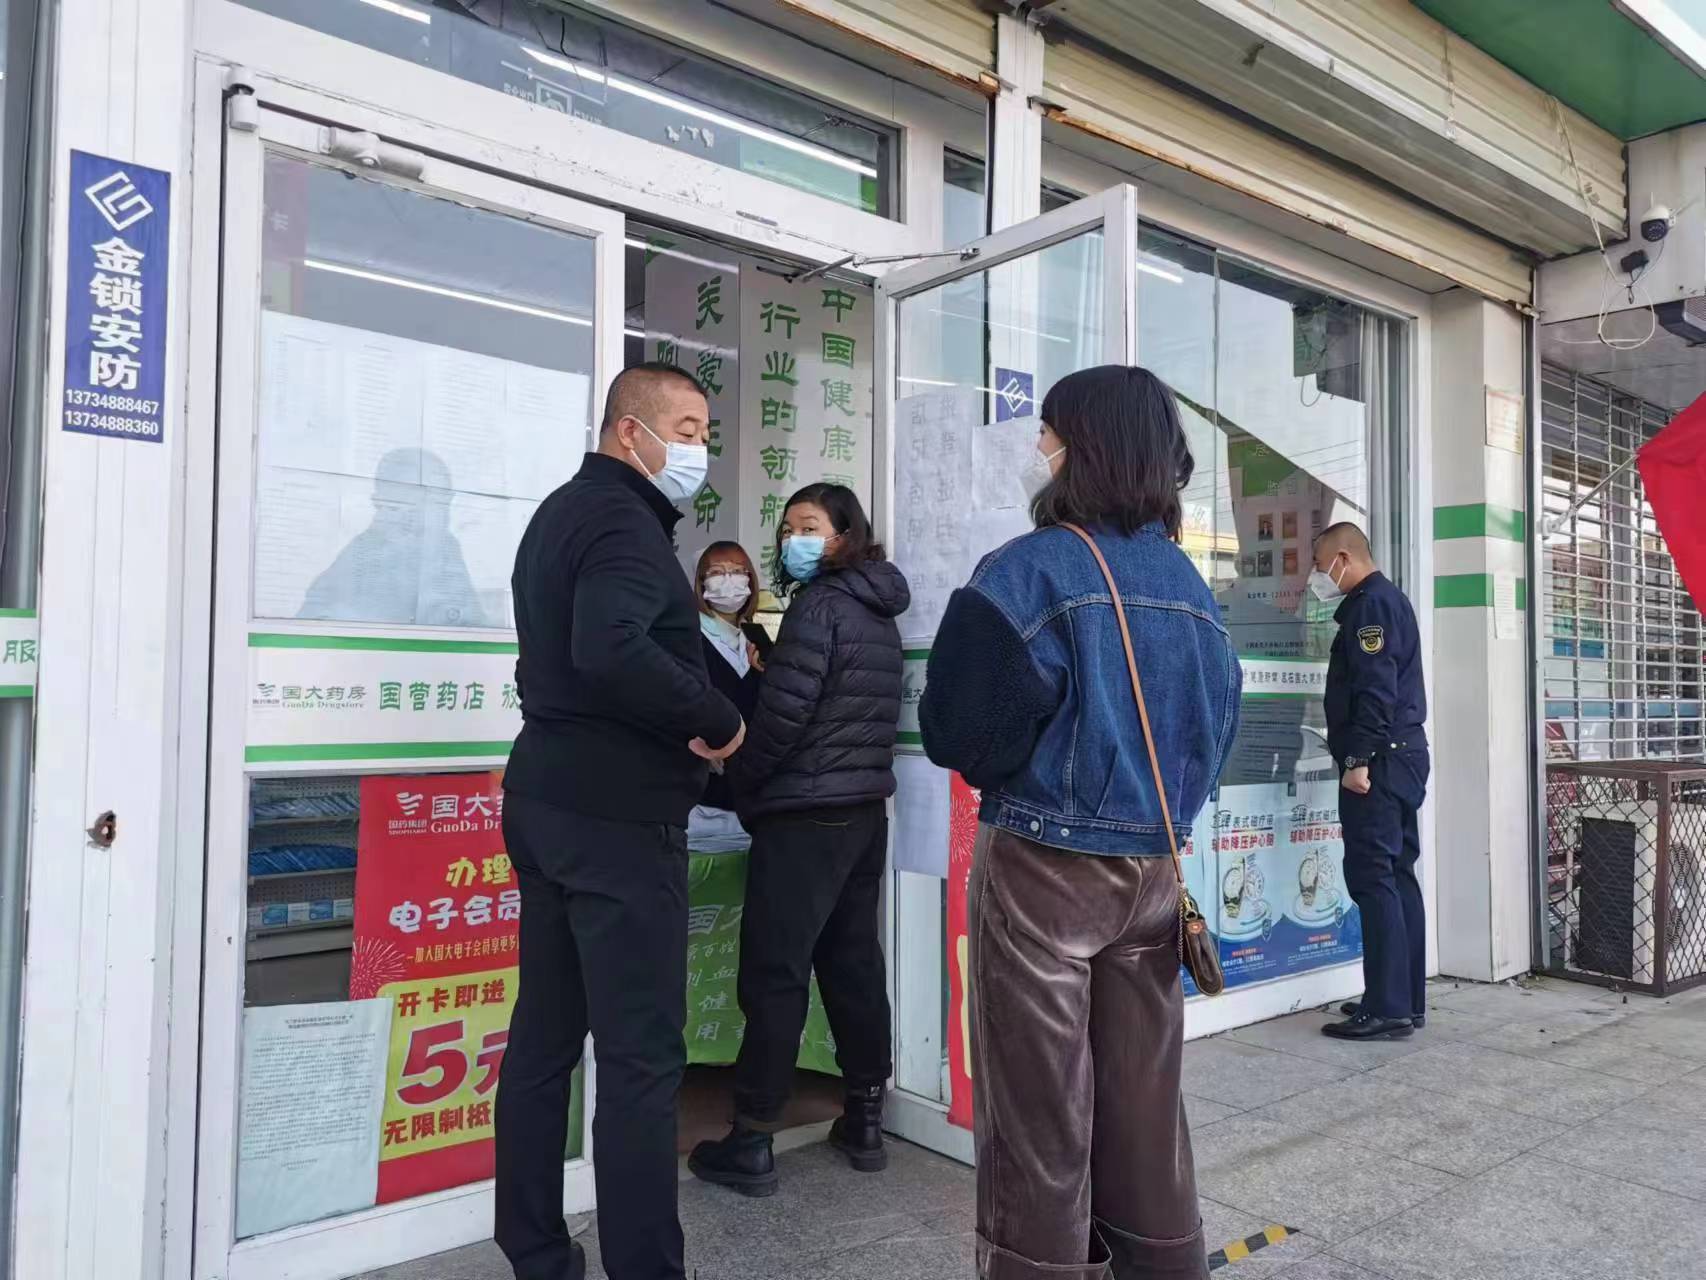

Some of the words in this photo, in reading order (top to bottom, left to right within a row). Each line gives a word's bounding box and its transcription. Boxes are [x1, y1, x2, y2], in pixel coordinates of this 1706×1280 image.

[89, 236, 145, 391] 金锁安防
[65, 388, 160, 415] 13734888467
[64, 410, 159, 436] 13734888360
[3, 639, 36, 664] 服
[282, 685, 367, 702] 国大药房
[379, 680, 485, 712] 国营药店
[430, 819, 479, 834] GuoDa
[445, 853, 514, 888] 办理
[388, 889, 521, 933] 电子会员
[397, 979, 506, 1017] 开卡即送
